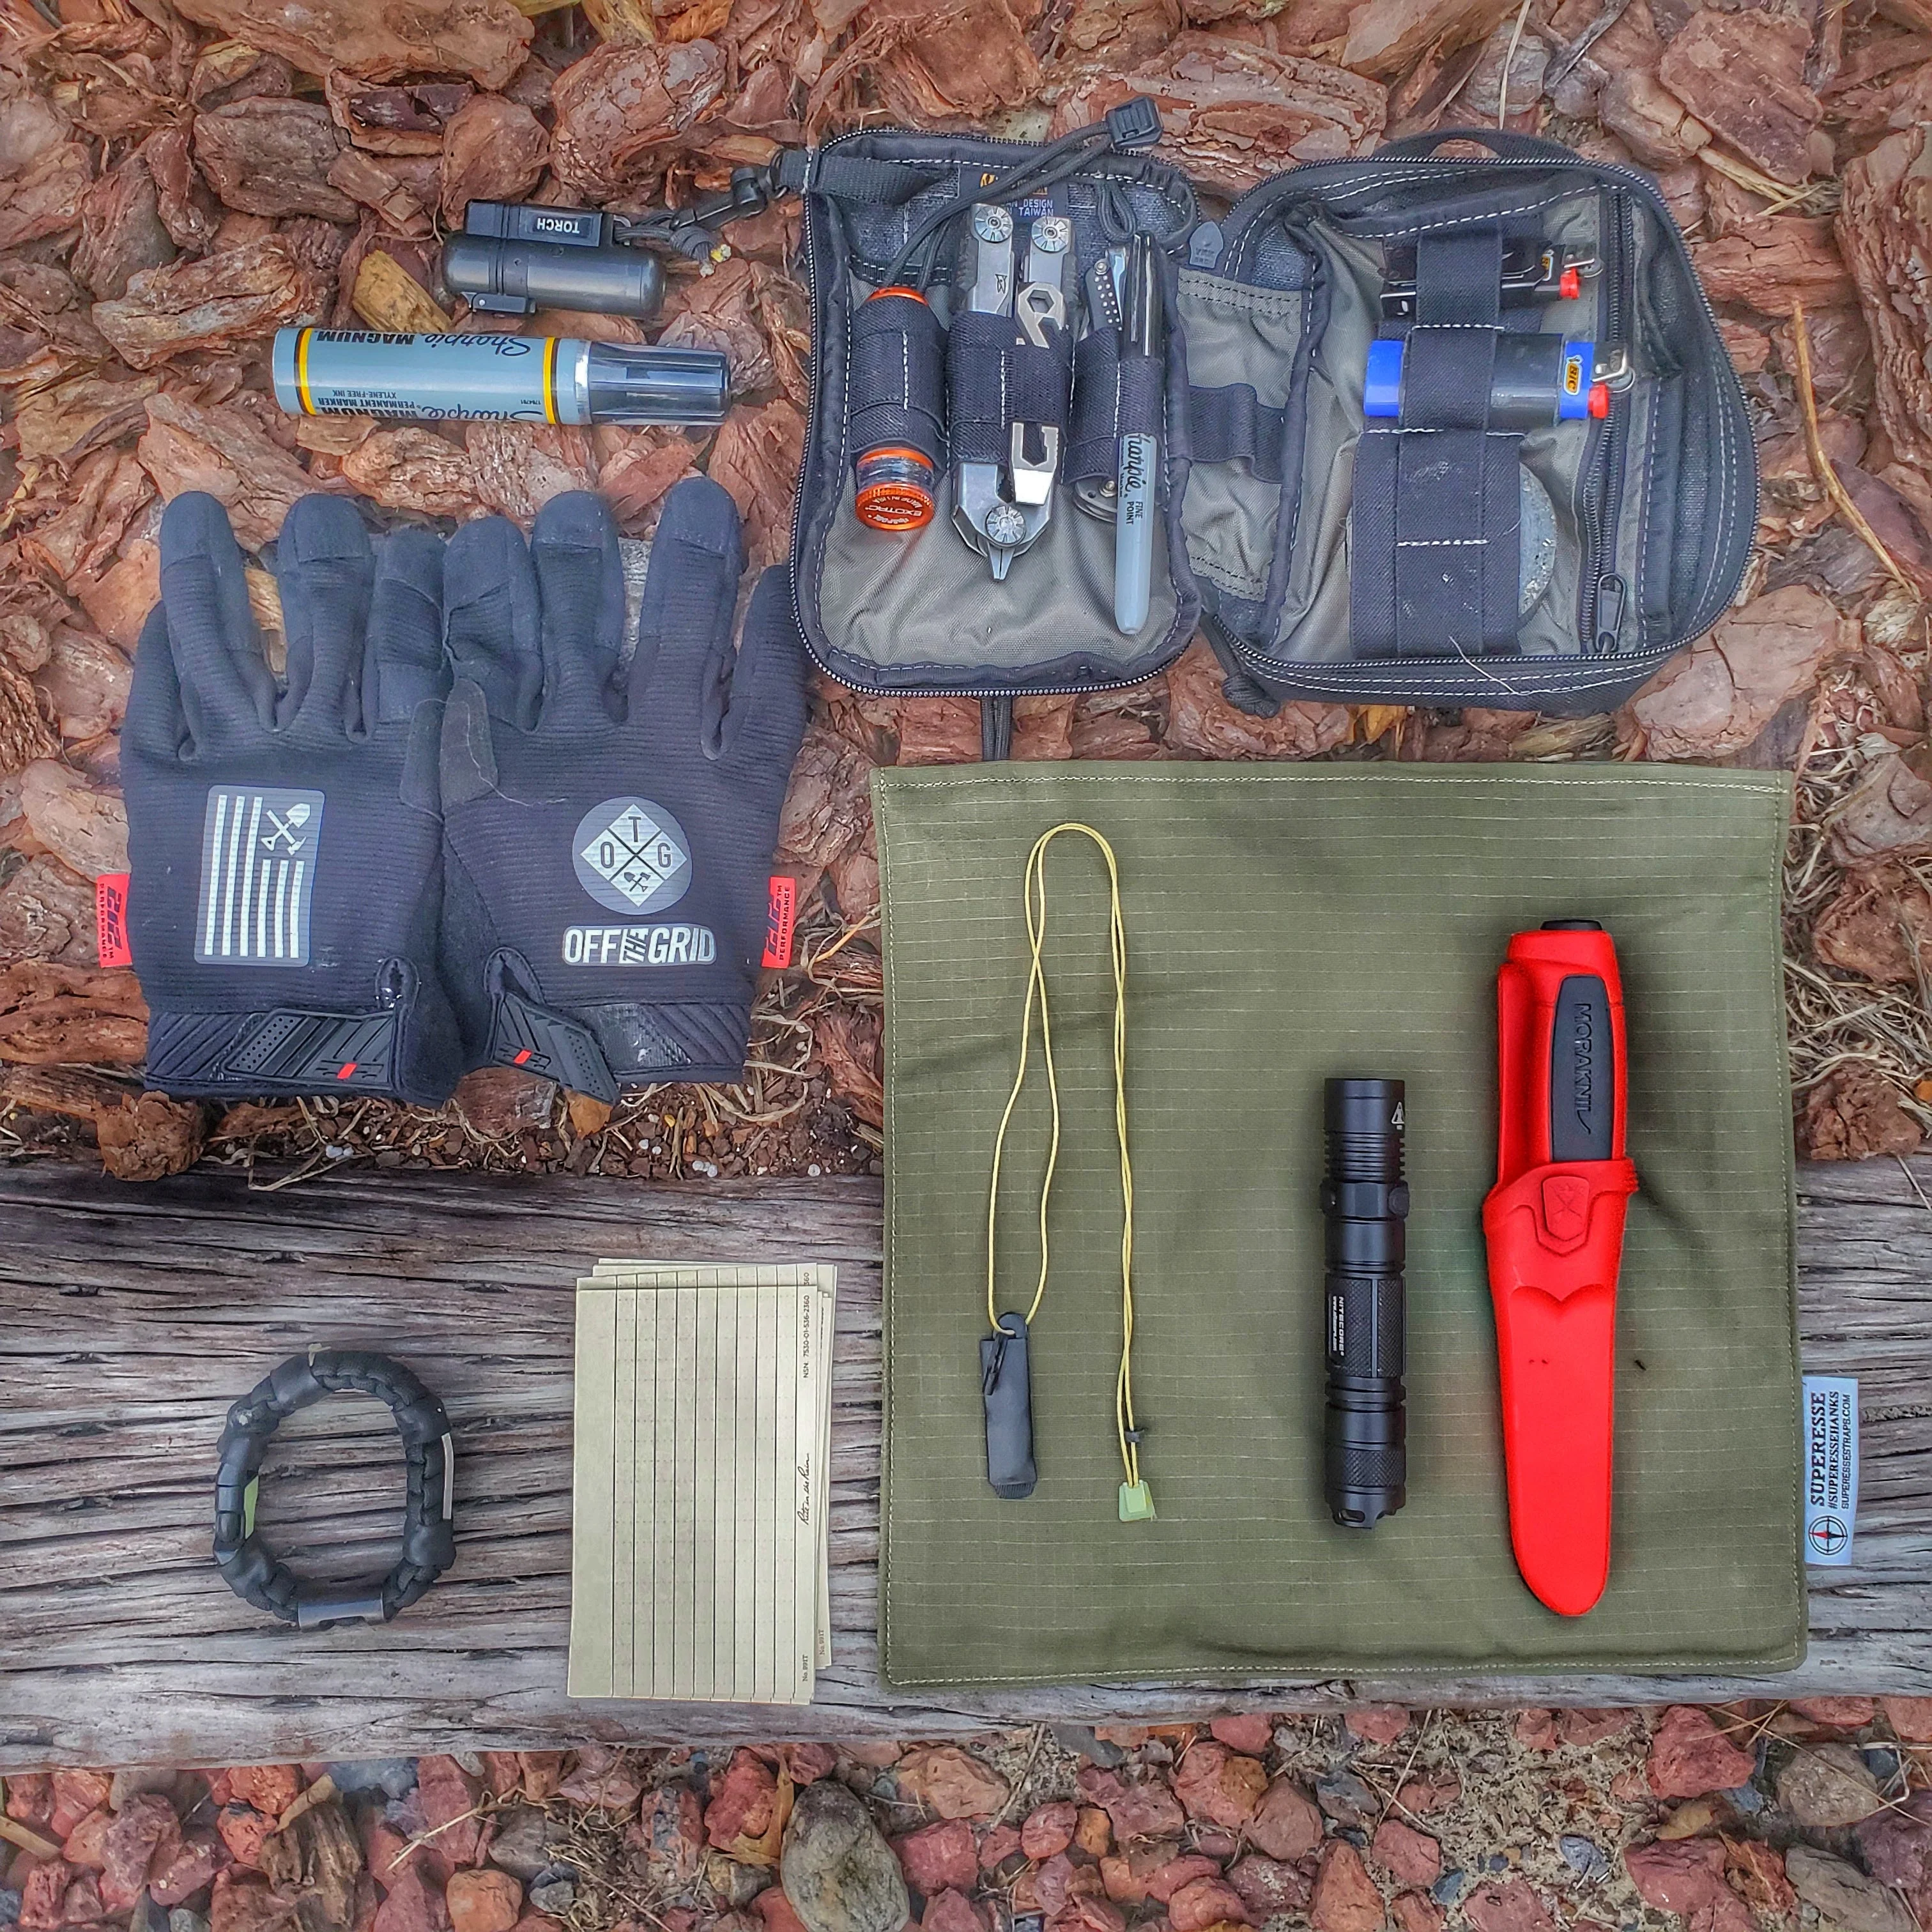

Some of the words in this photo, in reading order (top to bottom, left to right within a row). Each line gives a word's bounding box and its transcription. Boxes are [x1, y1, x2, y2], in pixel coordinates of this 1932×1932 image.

[1019, 207, 1054, 217] TAIWAN
[1023, 199, 1053, 208] DESIGN
[537, 218, 580, 234] TORCH
[317, 331, 415, 345] MAGNUM
[422, 334, 544, 356] Sharpie
[318, 397, 358, 406] MARKER
[347, 390, 397, 399] XYLENE-FREE
[360, 399, 415, 409] PERMANENT
[1123, 434, 1151, 493] harpie
[1126, 502, 1134, 525] POINT
[779, 885, 790, 960] PERFORMANCE
[564, 928, 621, 963] OFF
[648, 927, 715, 963] GRID
[1811, 1392, 1826, 1506] SUPERESSE
[1828, 1391, 1839, 1510] #SUPERESSEHANKS
[1841, 1394, 1851, 1510] SUPERESSESTRAPS.COM
